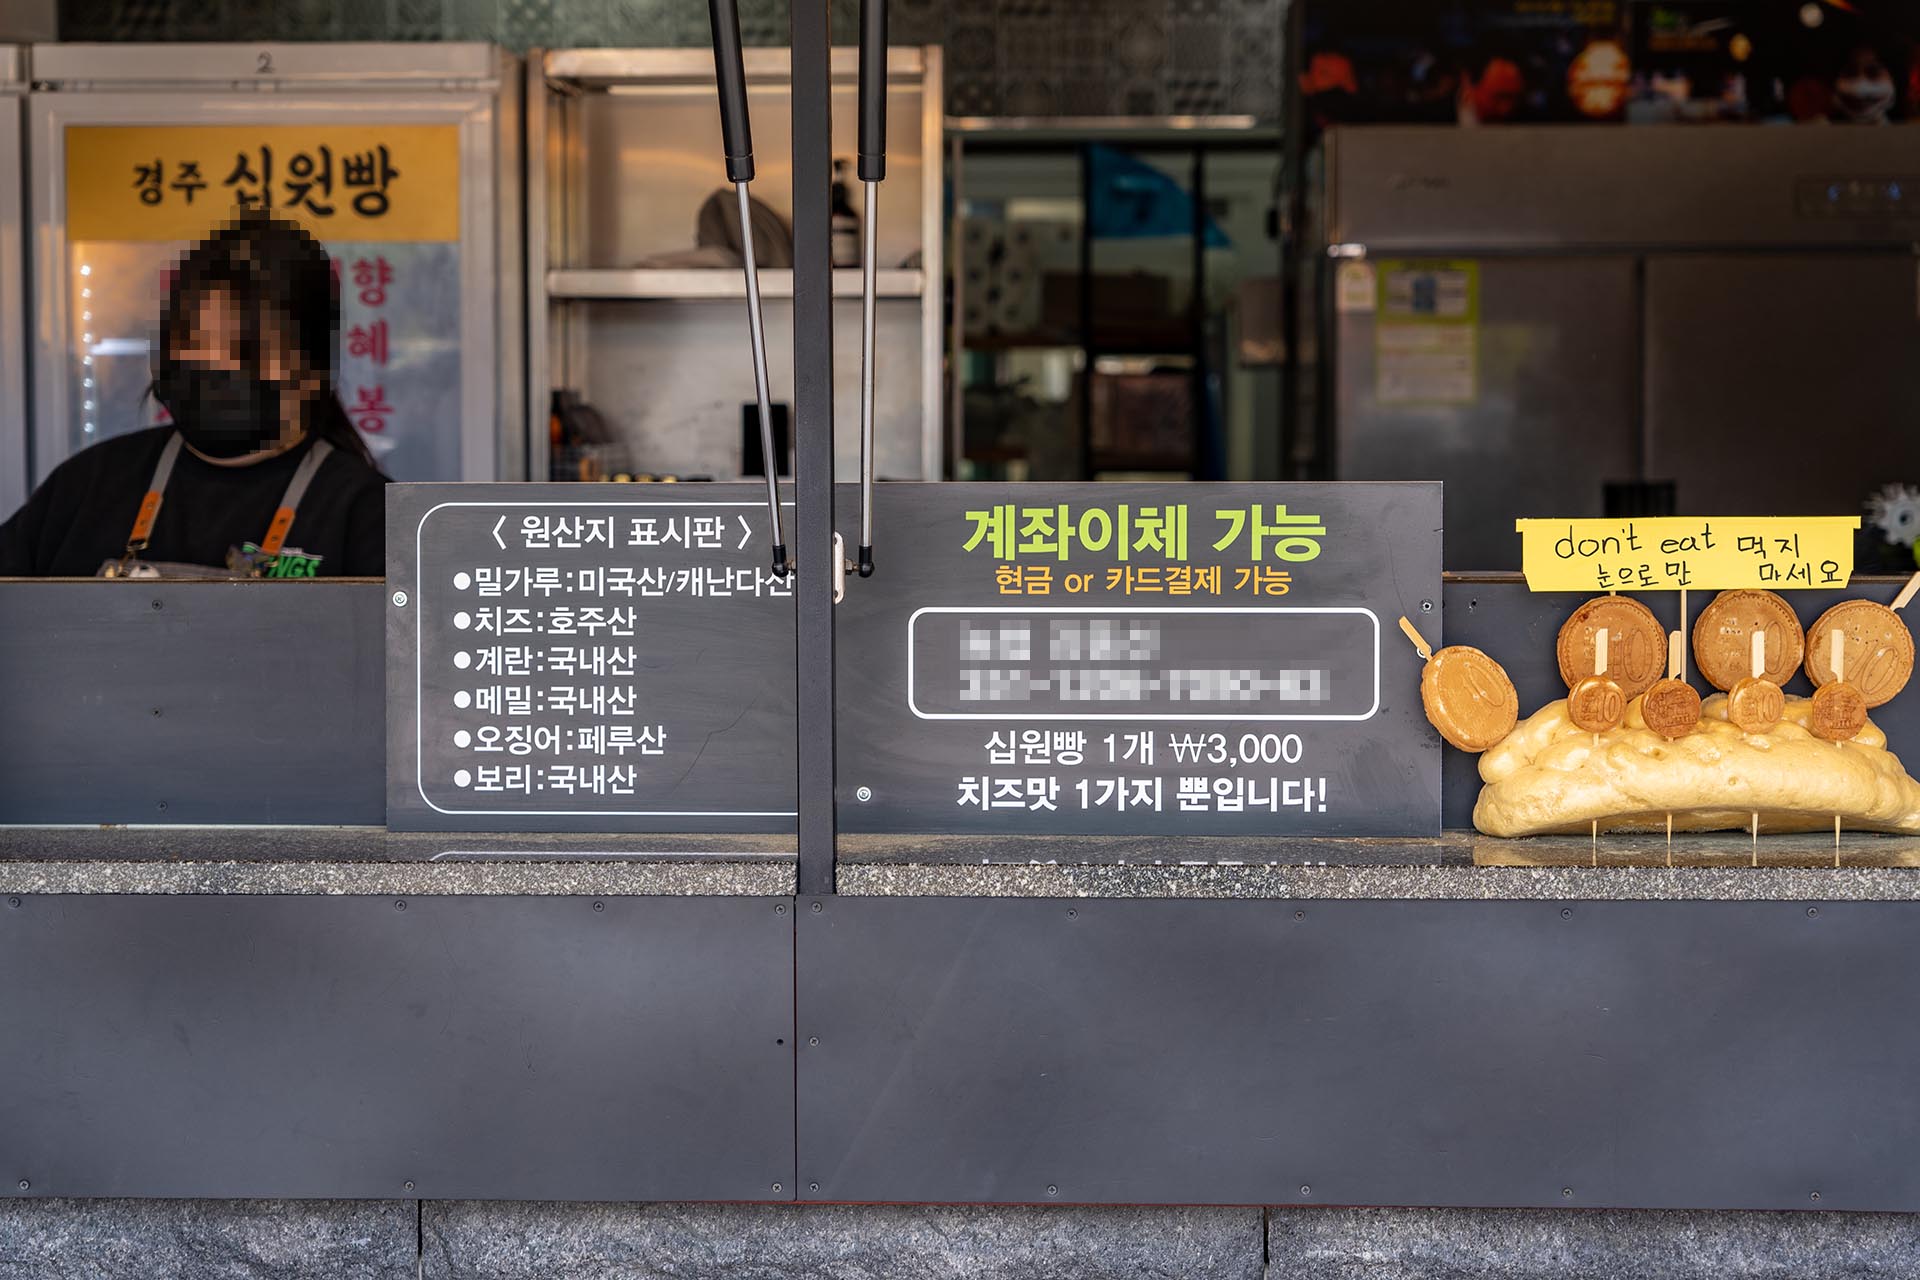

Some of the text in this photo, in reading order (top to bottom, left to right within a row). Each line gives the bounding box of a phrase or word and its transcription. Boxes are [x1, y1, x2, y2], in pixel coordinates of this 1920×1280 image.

[256, 52, 274, 73] 2
[133, 144, 399, 217] 경주 십원빵
[520, 515, 726, 549] 원산지 표시판
[963, 505, 1326, 561] 계좌이체 가능
[1554, 523, 1800, 559] don't eat 먹지
[995, 566, 1293, 596] 현금 or 카드결제 가능
[1759, 559, 1843, 584] 마세요
[474, 606, 638, 637] 치즈:호주산
[474, 645, 638, 677] 계란:국내산
[474, 685, 638, 716] 메밀:국내산
[473, 724, 668, 756] 오징어:페루산
[983, 730, 1303, 770] 십원빵 1개 ₩3,000
[474, 764, 638, 795] 보리:국내산
[956, 776, 1328, 813] 치즈맛 1가지 뿐입니다!
